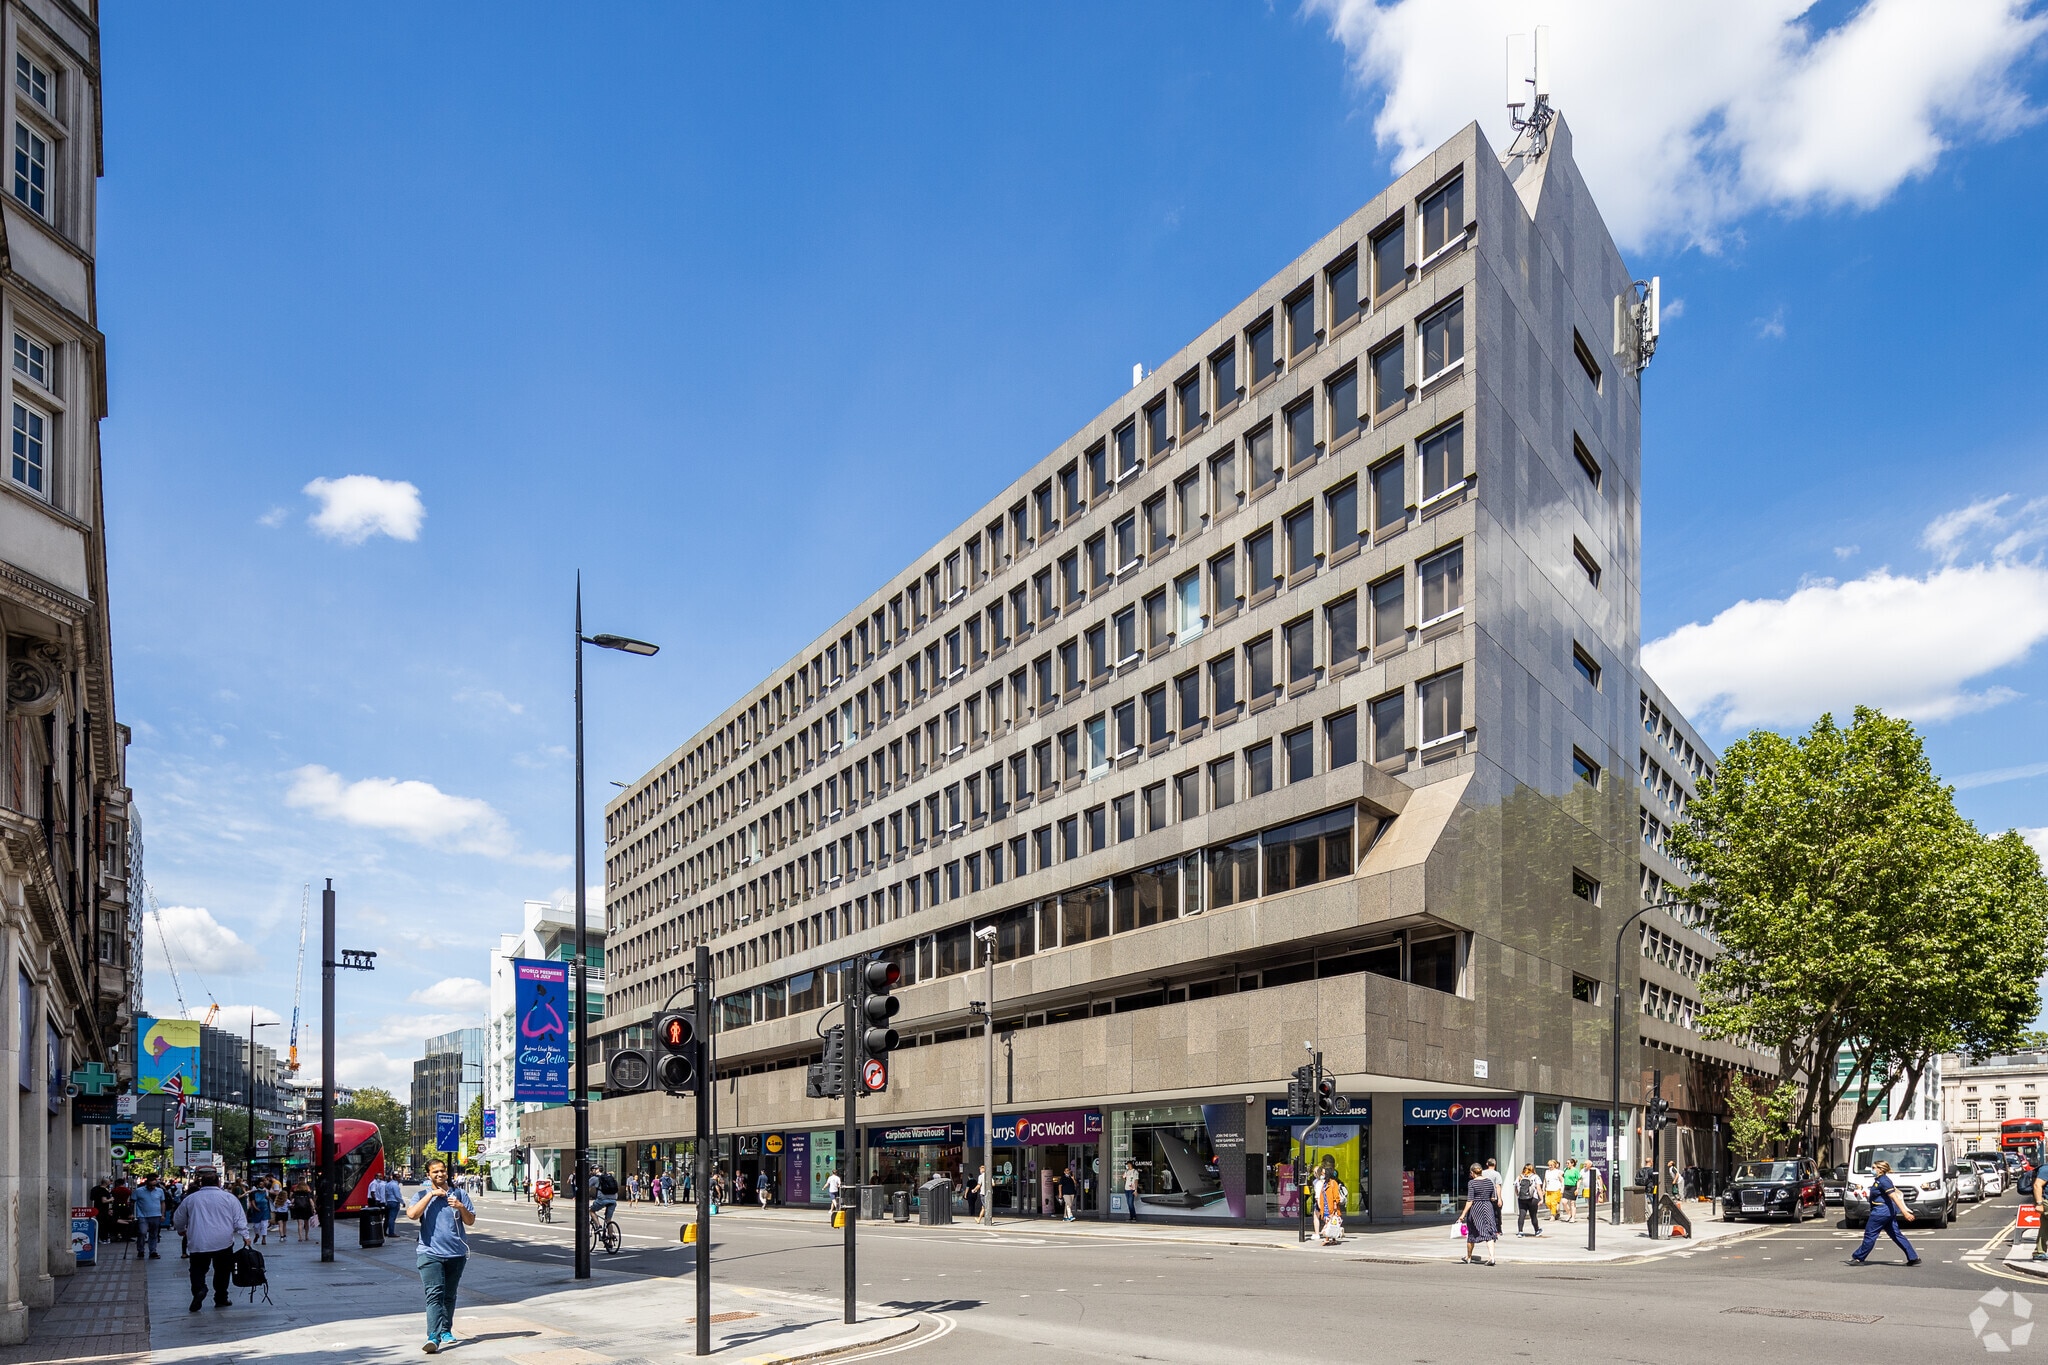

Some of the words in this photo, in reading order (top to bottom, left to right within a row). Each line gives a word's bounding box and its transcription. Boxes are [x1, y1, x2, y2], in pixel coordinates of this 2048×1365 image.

[1411, 1107, 1447, 1120] Currys
[1465, 1107, 1480, 1118] PC
[1481, 1107, 1511, 1118] World
[885, 1130, 912, 1141] Carphone
[912, 1128, 945, 1138] Warehouse
[992, 1126, 1015, 1140] urrys
[1031, 1123, 1045, 1137] PC
[1045, 1121, 1074, 1136] World
